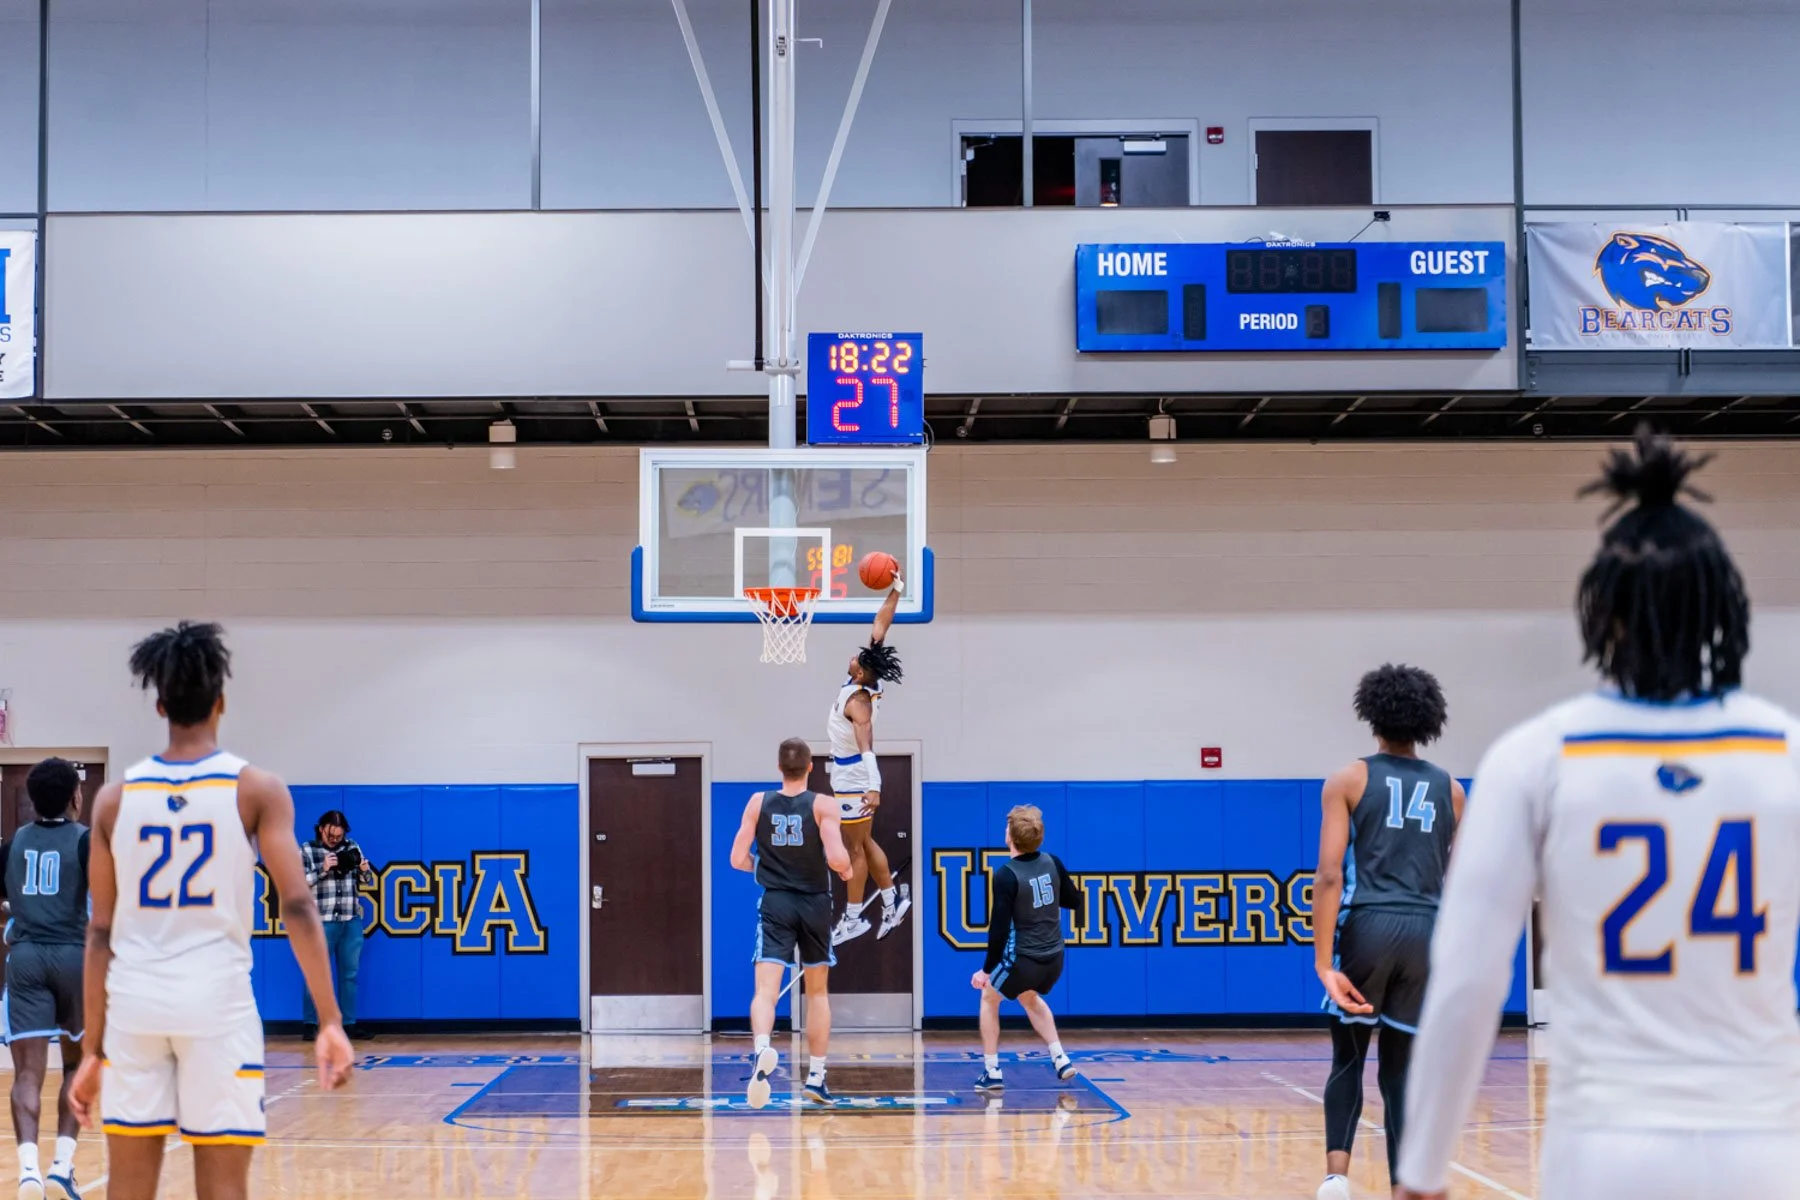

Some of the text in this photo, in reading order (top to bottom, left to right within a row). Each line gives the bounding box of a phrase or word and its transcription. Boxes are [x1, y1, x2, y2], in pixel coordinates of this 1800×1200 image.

[1097, 252, 1168, 276] HOME
[1410, 250, 1489, 275] GUEST
[837, 332, 894, 340] DAKTRONICS
[1239, 313, 1298, 330] PERIOD
[1579, 305, 1733, 336] BEARCATS
[829, 341, 912, 374] 18:22
[832, 377, 899, 432] 27
[1385, 776, 1436, 833] 14
[771, 814, 804, 847] 33
[22, 849, 60, 896] 10
[138, 821, 215, 910] 22
[1029, 873, 1054, 909] 15
[1595, 817, 1769, 978] 24
